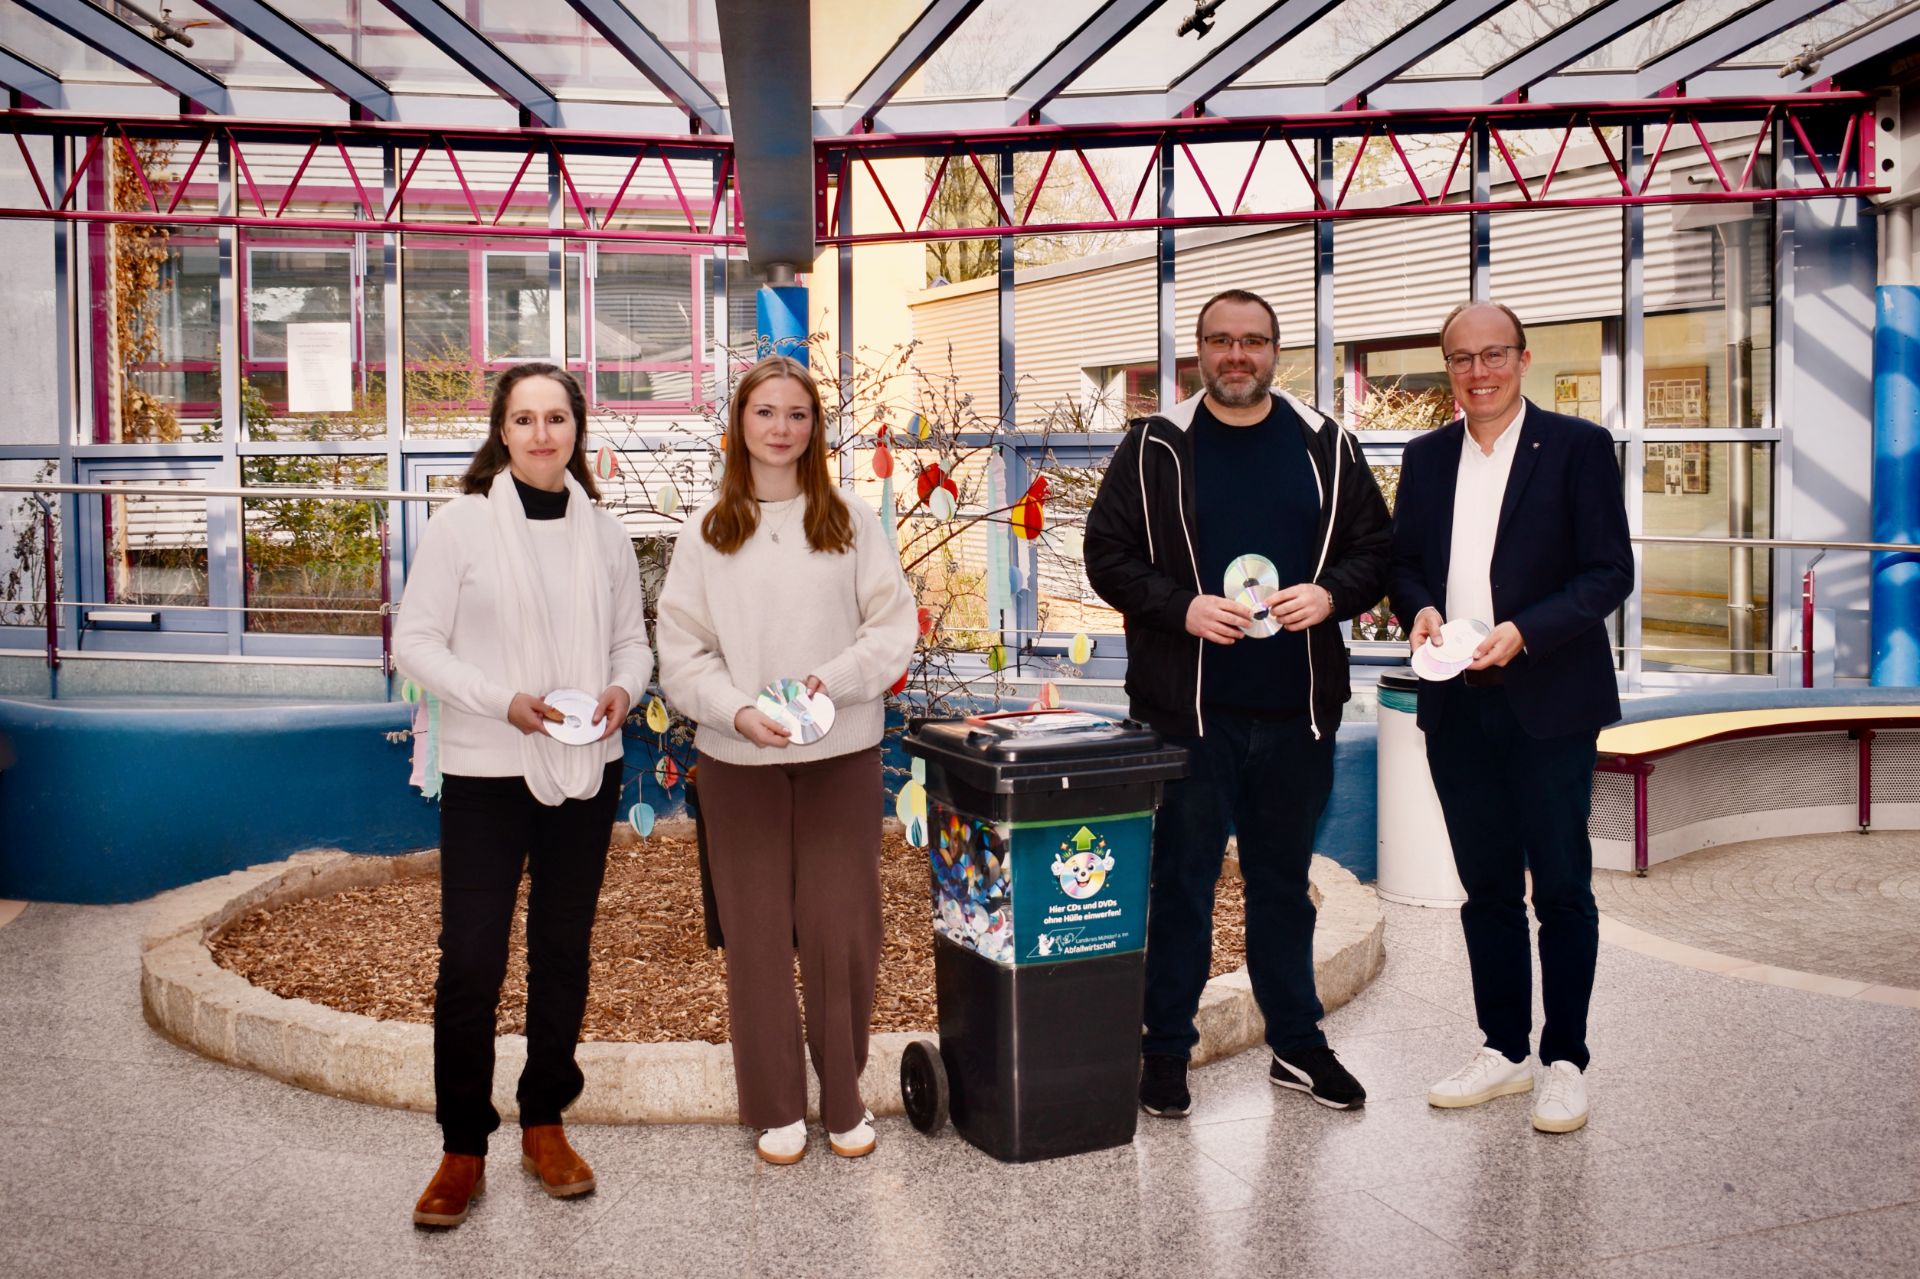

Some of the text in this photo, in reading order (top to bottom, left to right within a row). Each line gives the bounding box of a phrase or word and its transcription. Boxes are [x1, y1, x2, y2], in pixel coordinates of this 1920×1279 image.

[1049, 899, 1117, 913] Hier CDs und DVDs
[1044, 908, 1122, 924] ohne Hülle einwerfen!
[1064, 941, 1116, 954] Abfallwirtschaft
